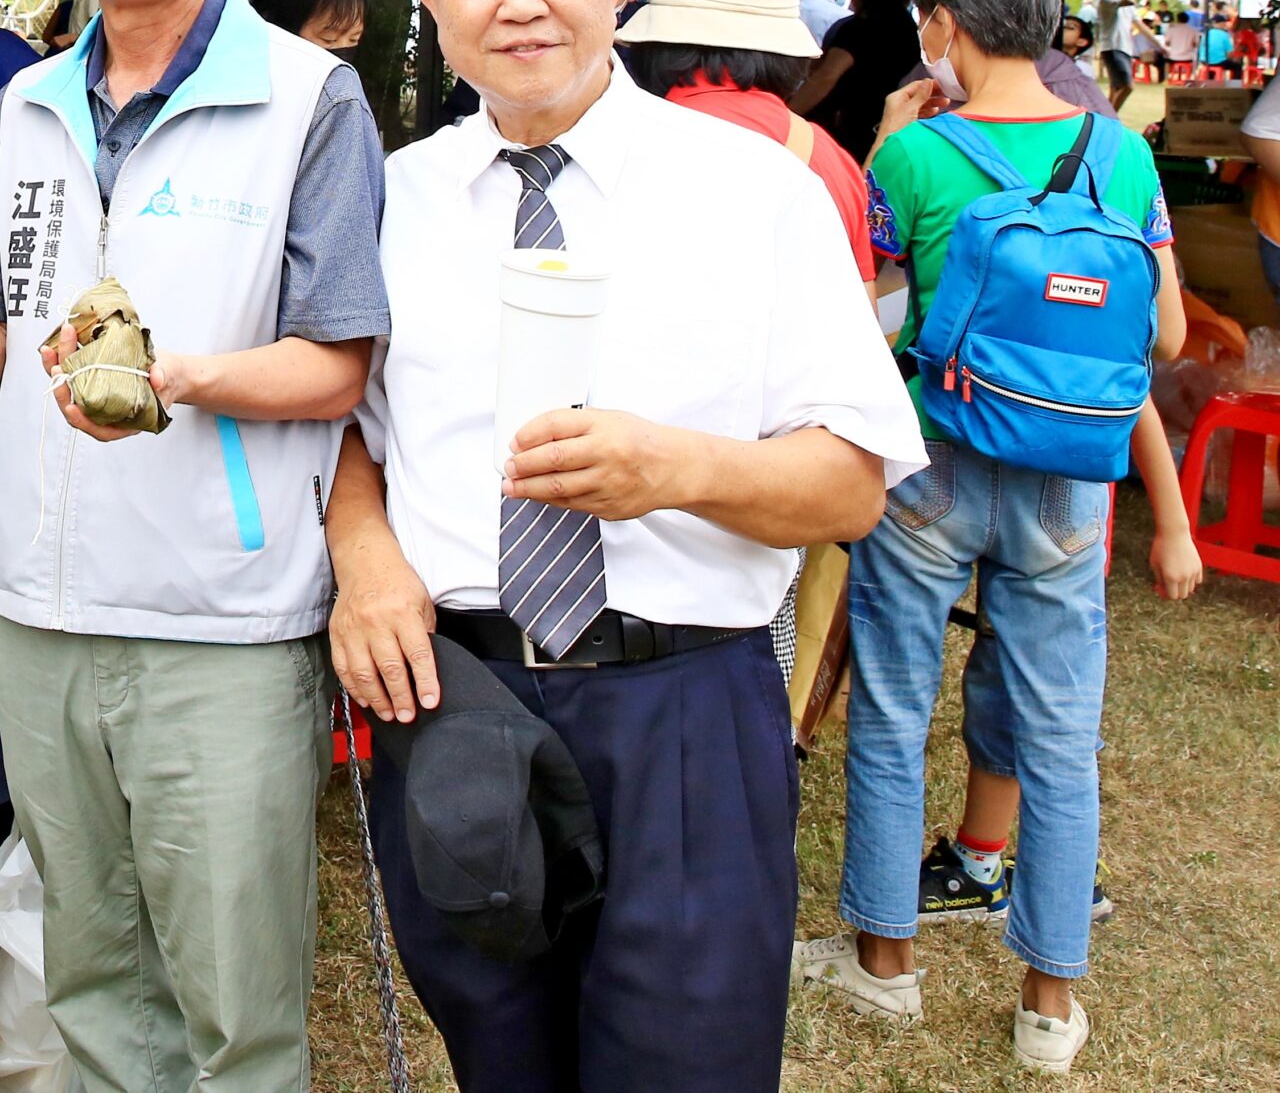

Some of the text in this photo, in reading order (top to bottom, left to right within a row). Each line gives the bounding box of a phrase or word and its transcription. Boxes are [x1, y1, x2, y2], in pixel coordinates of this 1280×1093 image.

[34, 179, 66, 320] 環境保護局局長
[1052, 283, 1101, 297] HUNTER
[944, 896, 982, 908] balance
